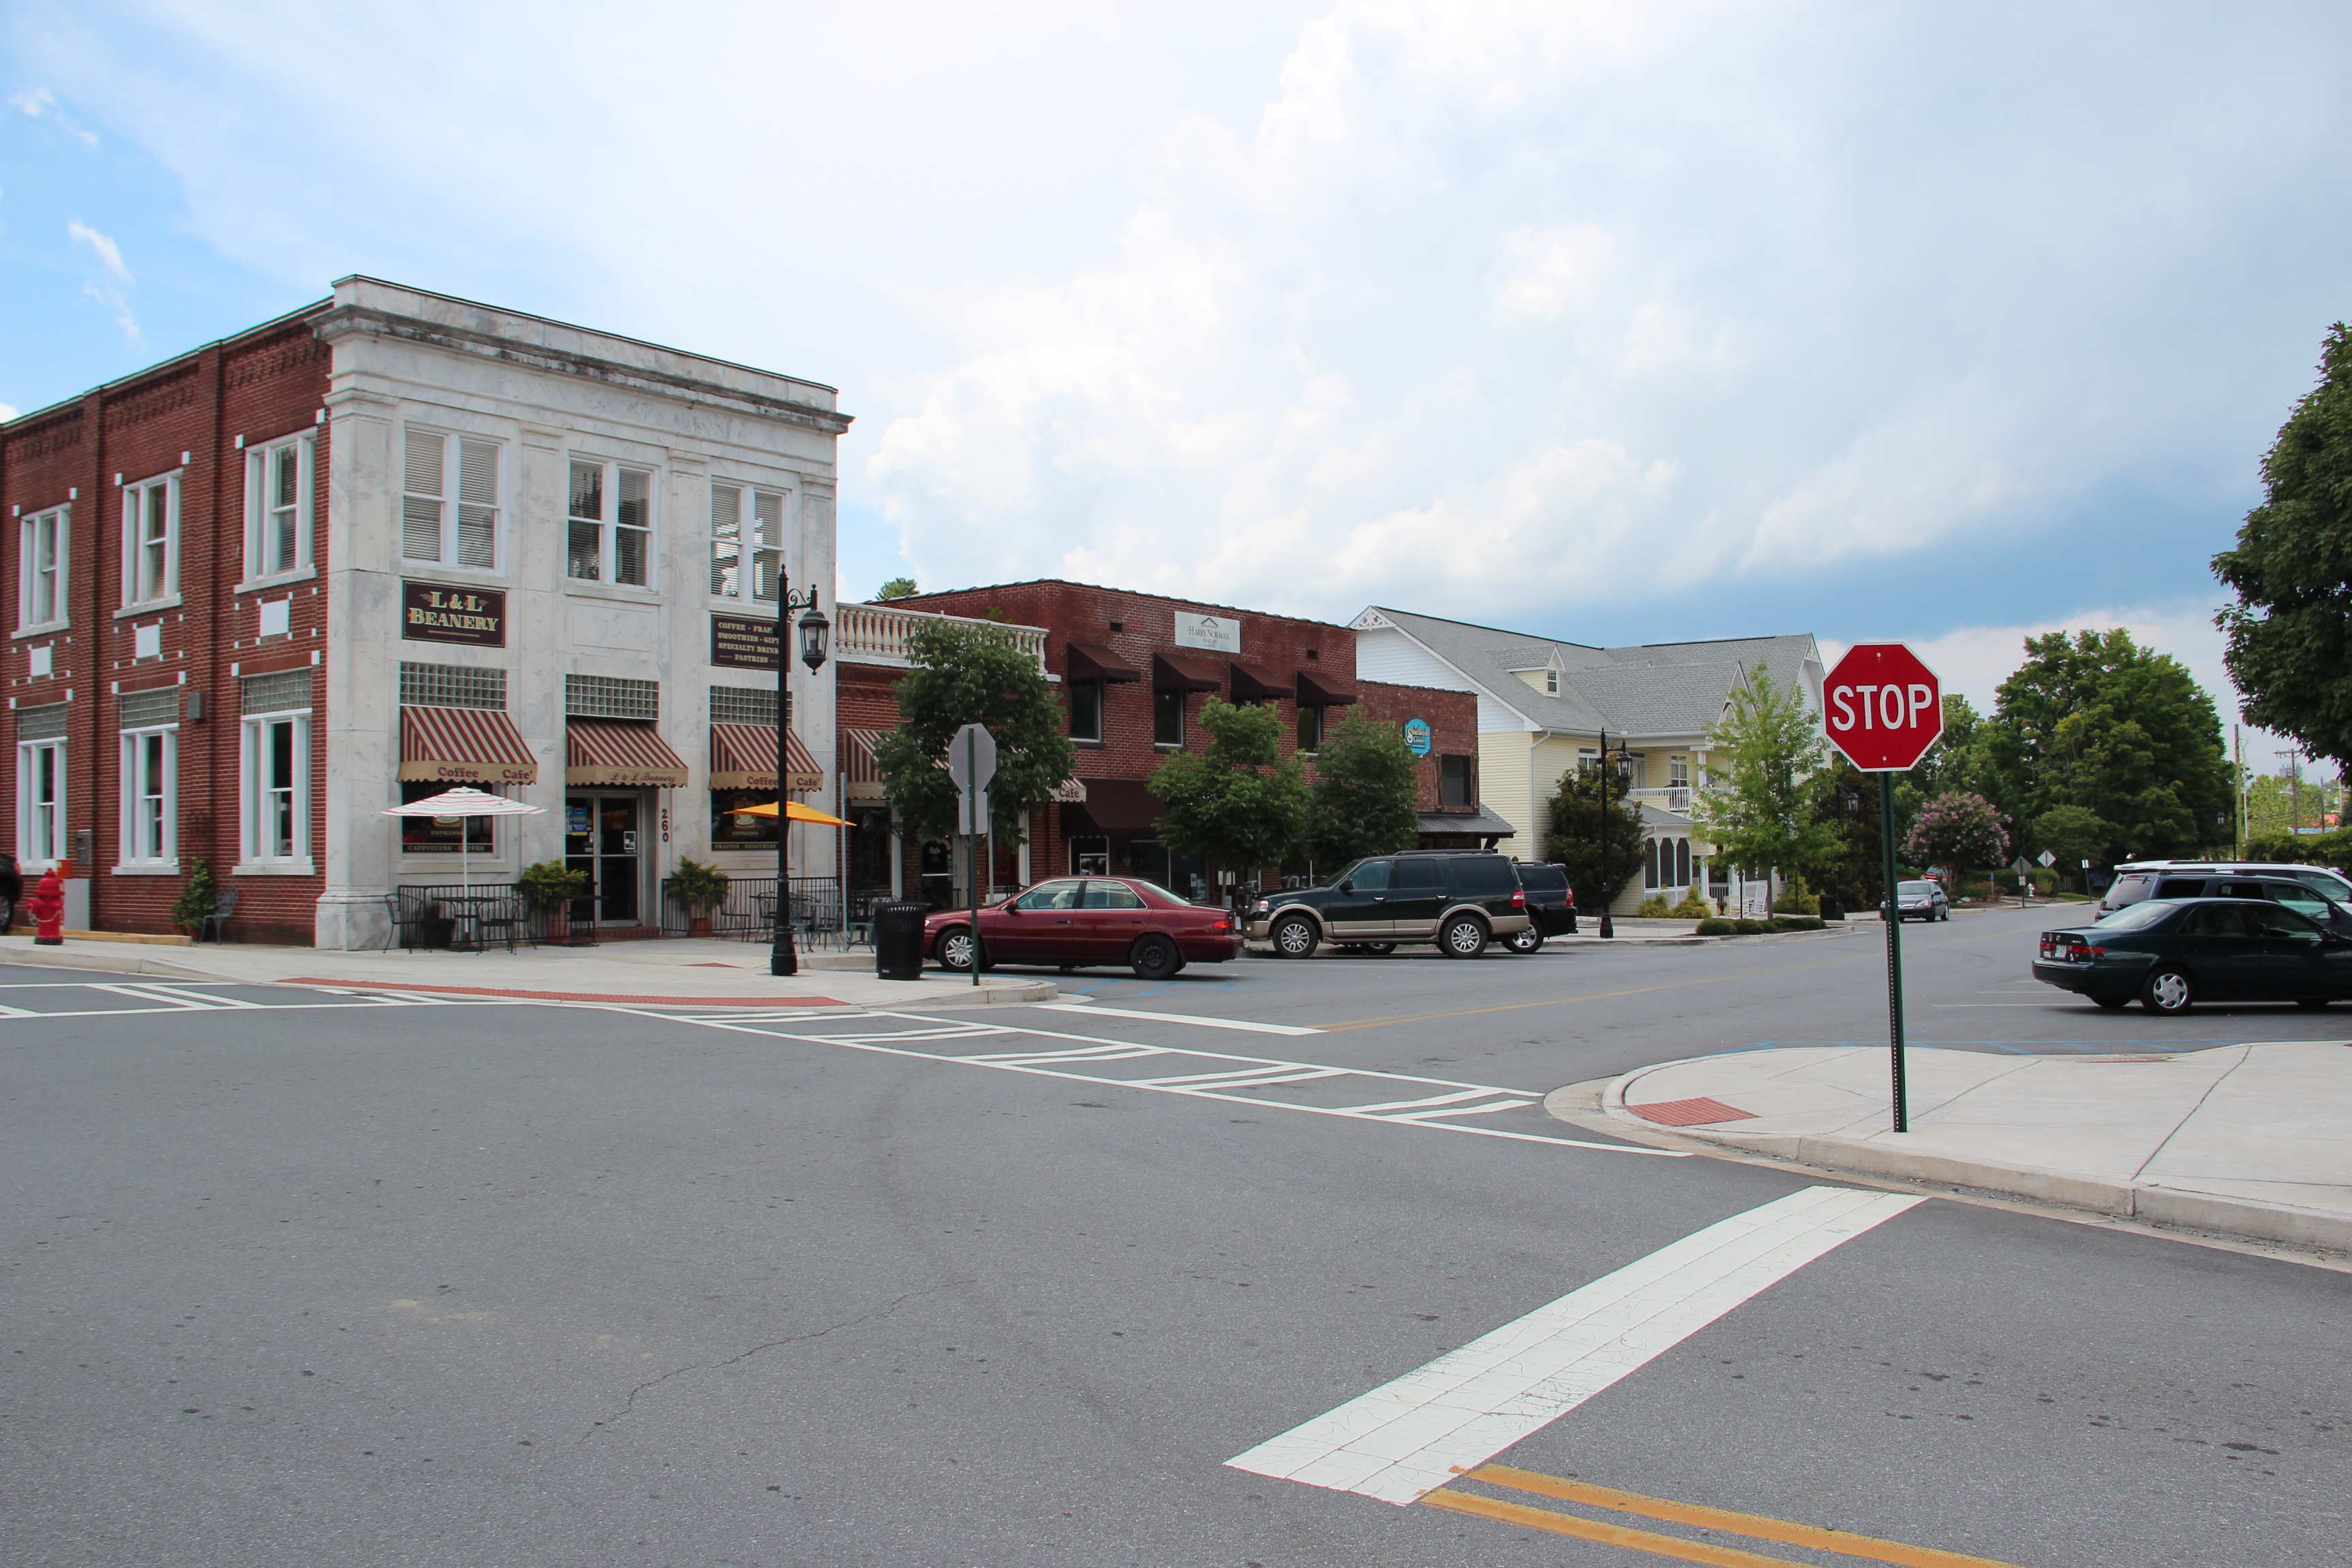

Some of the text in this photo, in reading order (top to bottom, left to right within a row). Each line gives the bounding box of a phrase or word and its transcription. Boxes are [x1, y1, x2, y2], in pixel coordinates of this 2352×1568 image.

[430, 591, 483, 612] L & L
[408, 608, 500, 632] BEANERY
[718, 622, 746, 631] COFFEE
[717, 632, 759, 642] SMOOTHIES
[1207, 629, 1230, 640] NORMAN
[718, 642, 756, 652] SPECIALTY
[734, 654, 768, 663] PASTRIES
[1832, 684, 1932, 732] STOP
[438, 767, 479, 777] Coffee
[640, 772, 676, 783] Beanery
[747, 777, 779, 785] Coffee
